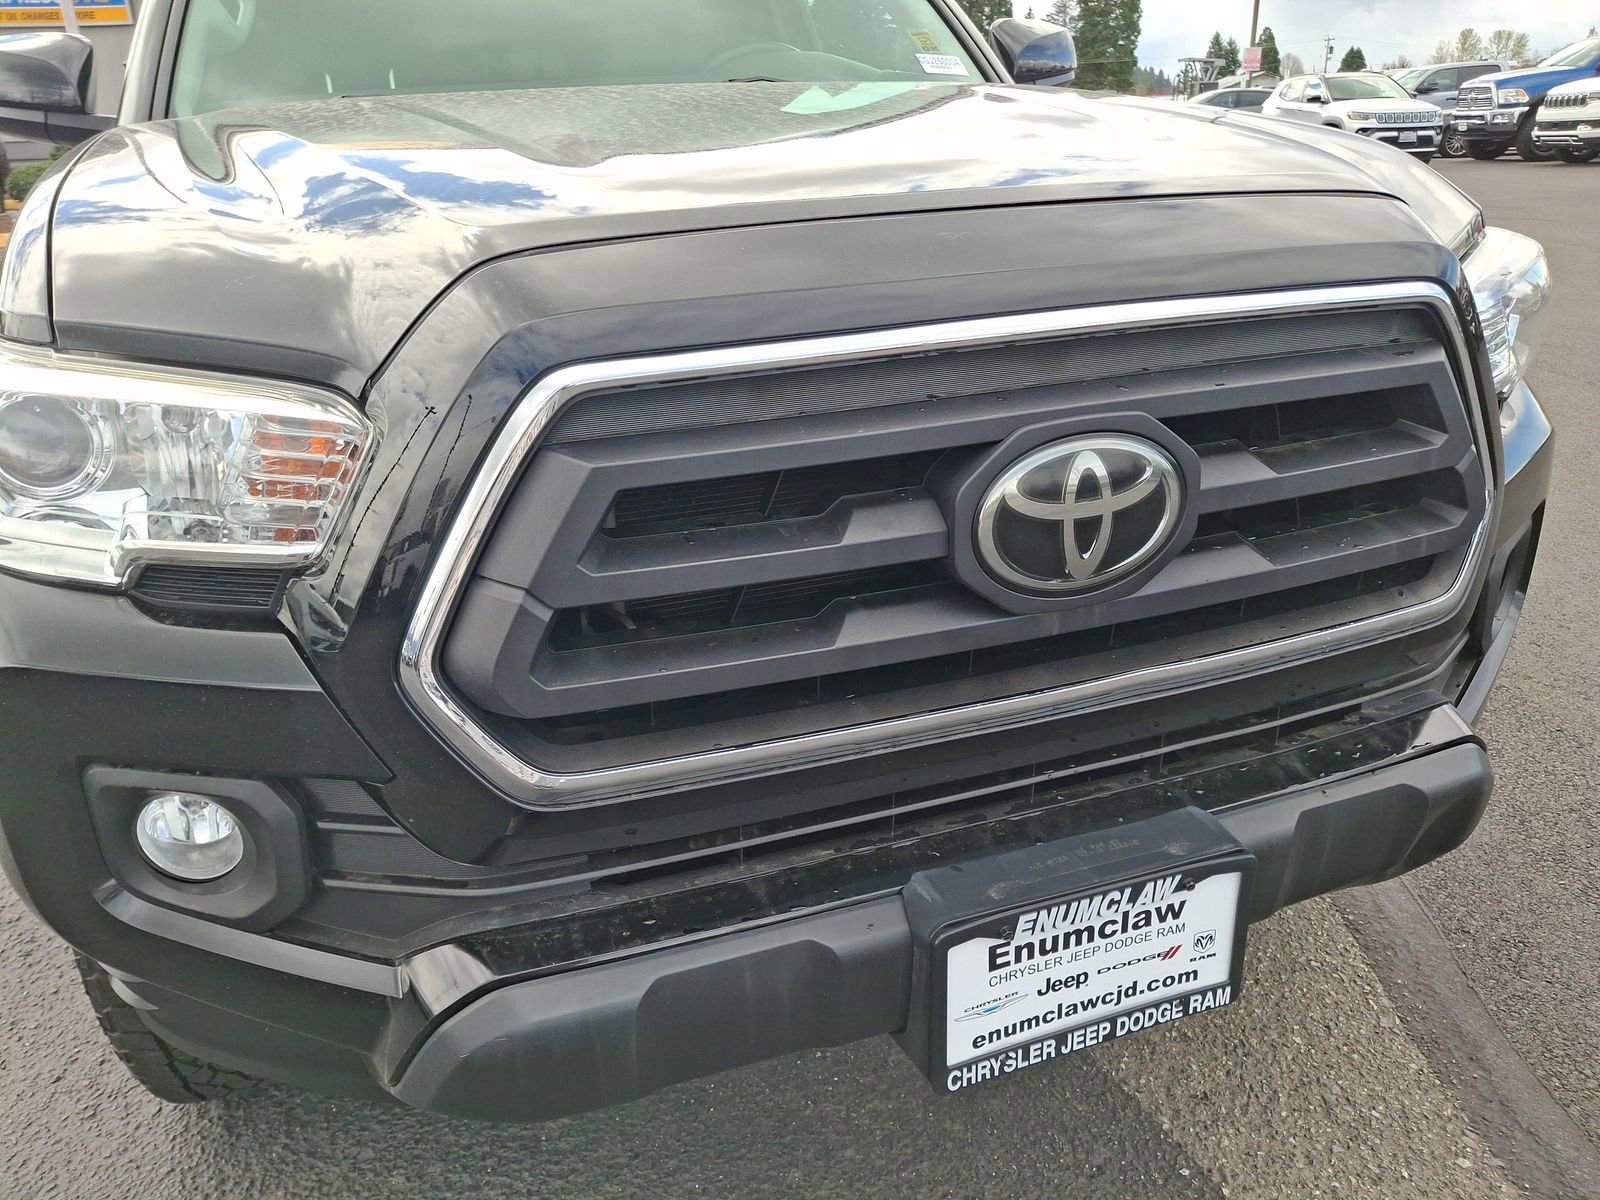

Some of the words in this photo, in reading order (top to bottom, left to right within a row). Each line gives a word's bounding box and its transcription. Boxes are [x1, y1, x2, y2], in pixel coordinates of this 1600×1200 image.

[6, 12, 18, 21] OIL
[21, 11, 60, 20] CHANGES
[1014, 874, 1182, 940] ENUMCLAW
[988, 900, 1187, 972] Enumclaw
[989, 956, 1063, 988] CHRYSLER
[1066, 945, 1101, 964] JEEP
[1104, 931, 1153, 953] DODGE
[1156, 922, 1187, 939] RAM
[1189, 952, 1217, 963] RAM
[1036, 971, 1089, 997] Jeep
[1097, 950, 1168, 975] DODGE
[963, 991, 1020, 1013] CHRYSLER
[971, 969, 1199, 1049] enumclawcjd.com
[947, 1039, 1056, 1092] CHRYSLER
[1061, 1022, 1111, 1054] JEEP
[1116, 999, 1184, 1036] DODGE
[1188, 986, 1231, 1015] RAM
